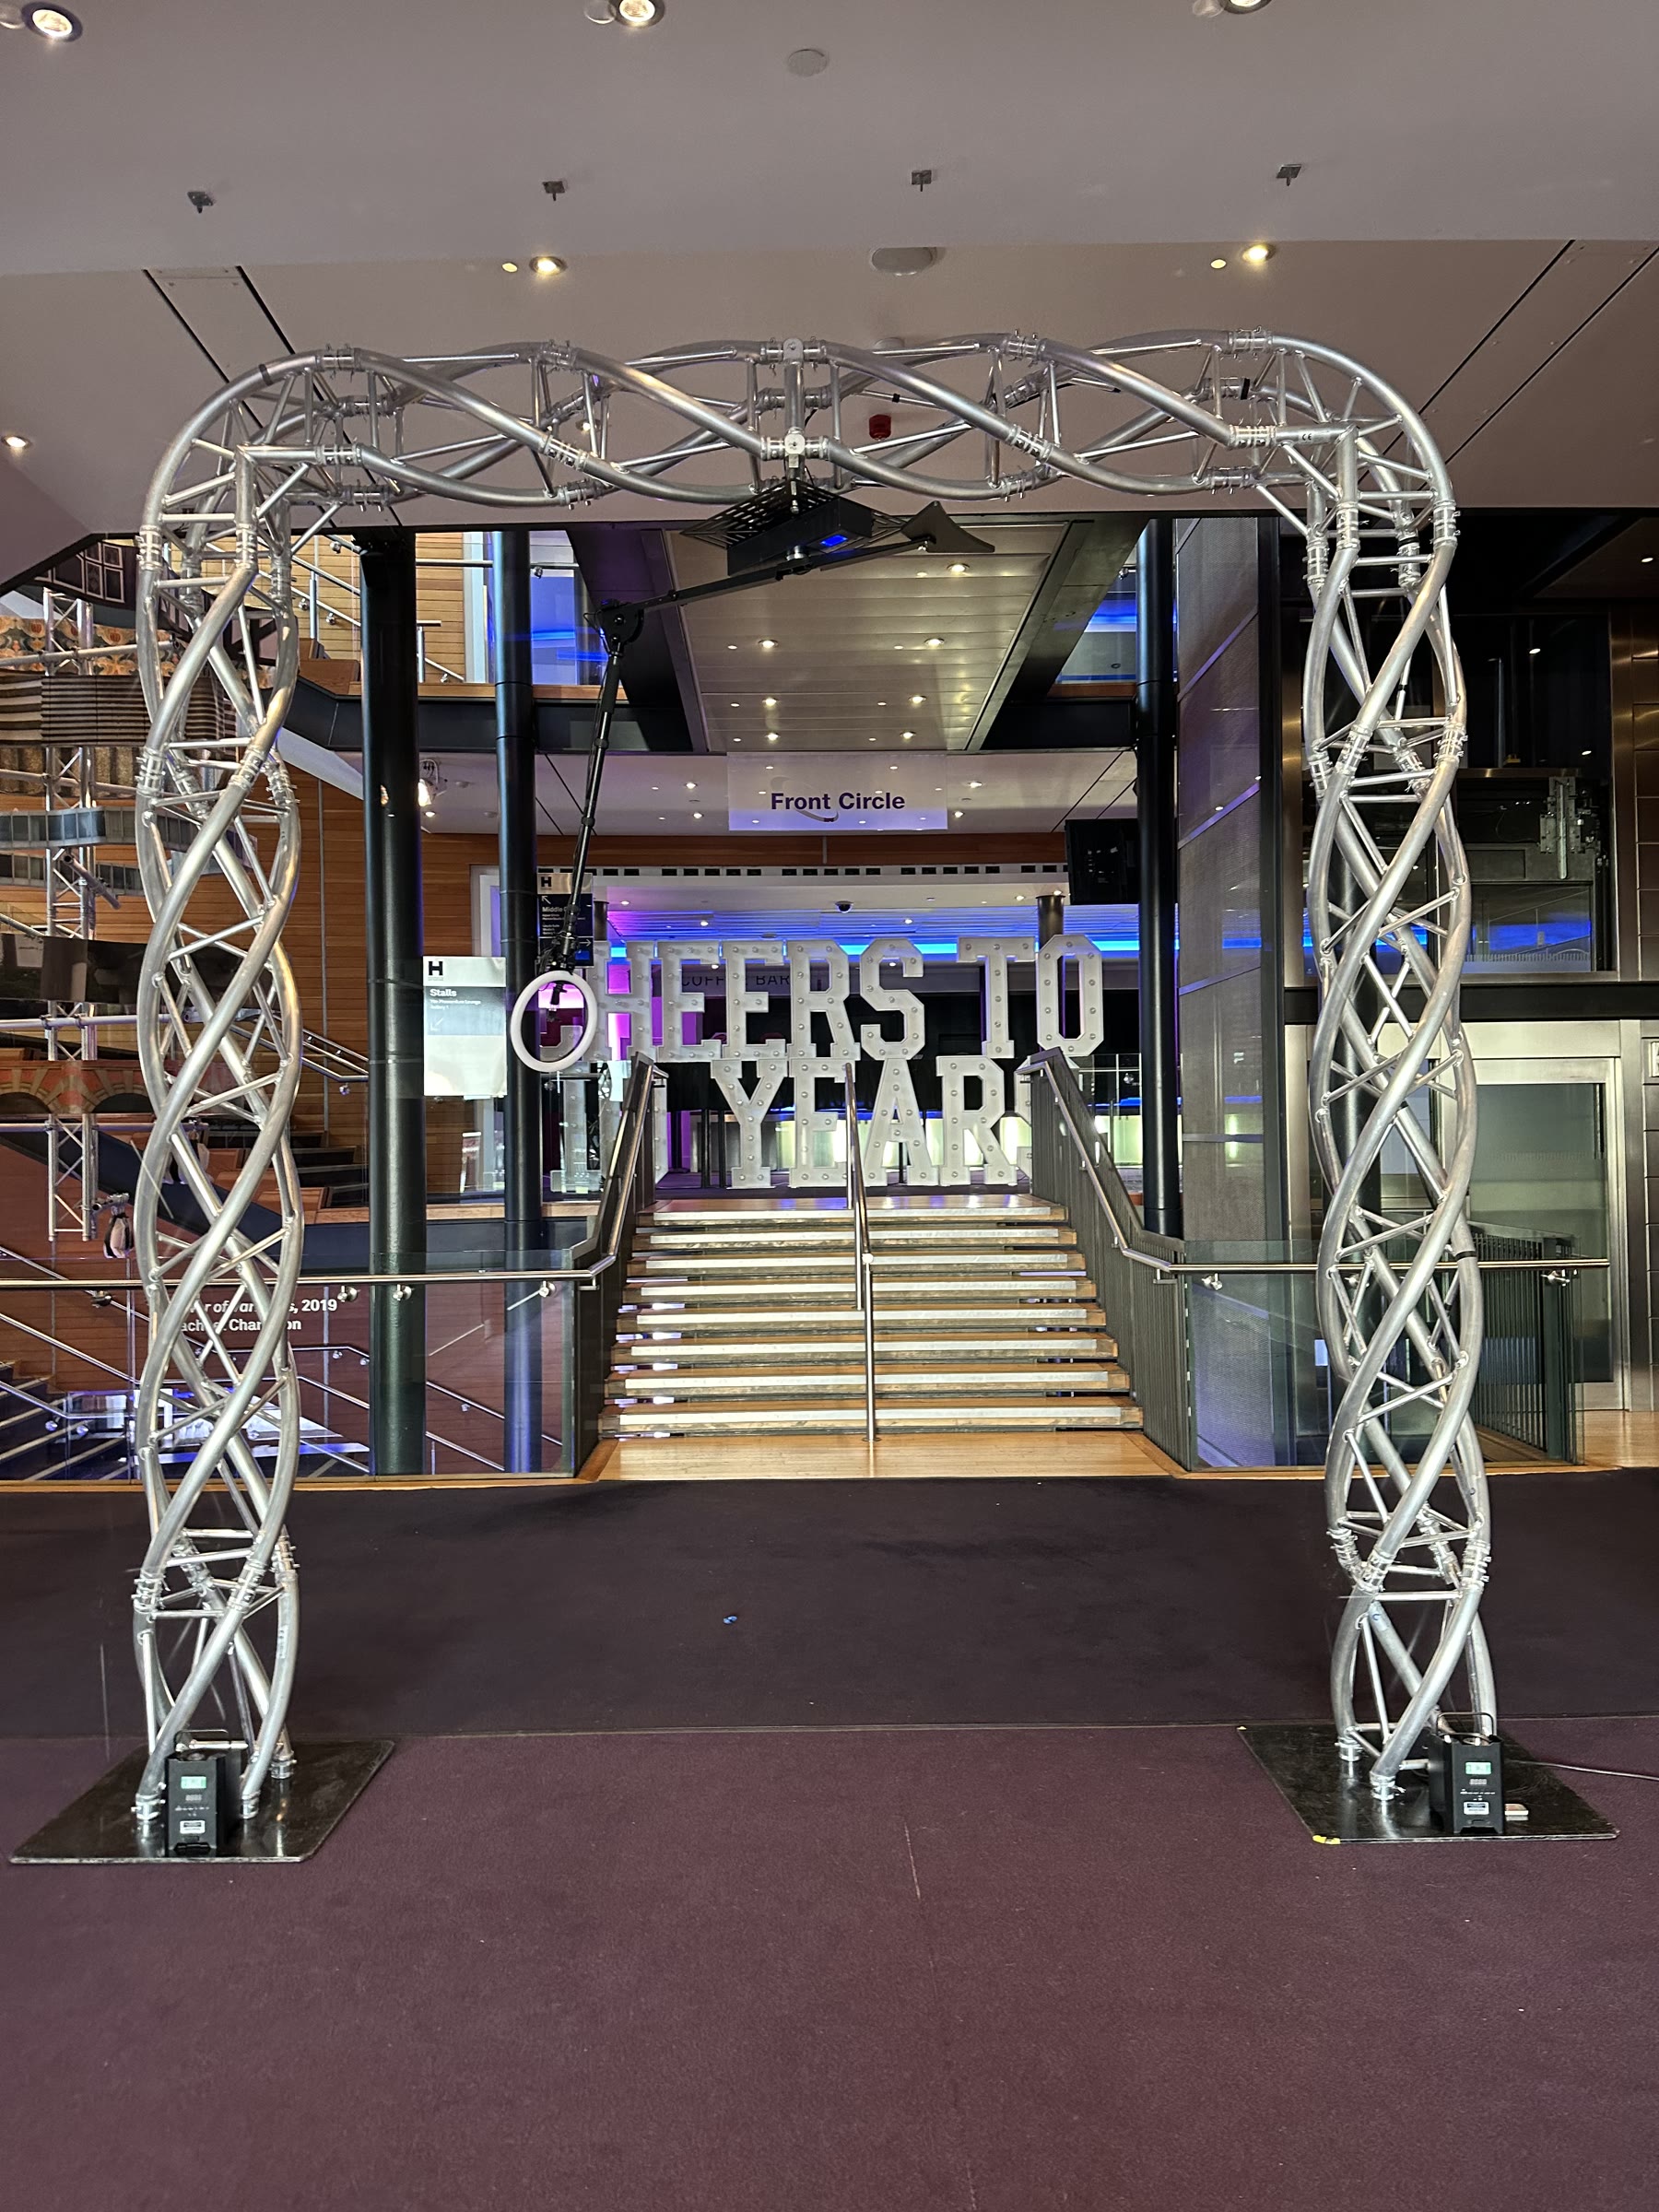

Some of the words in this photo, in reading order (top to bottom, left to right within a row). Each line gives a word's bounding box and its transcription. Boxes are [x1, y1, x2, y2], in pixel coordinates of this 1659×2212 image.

[771, 793, 831, 810] Front
[838, 792, 905, 810] Circle
[540, 877, 552, 887] H
[428, 960, 443, 976] H
[429, 988, 457, 997] Stalls
[956, 935, 1104, 1059] TO
[301, 1299, 338, 1312] 2019
